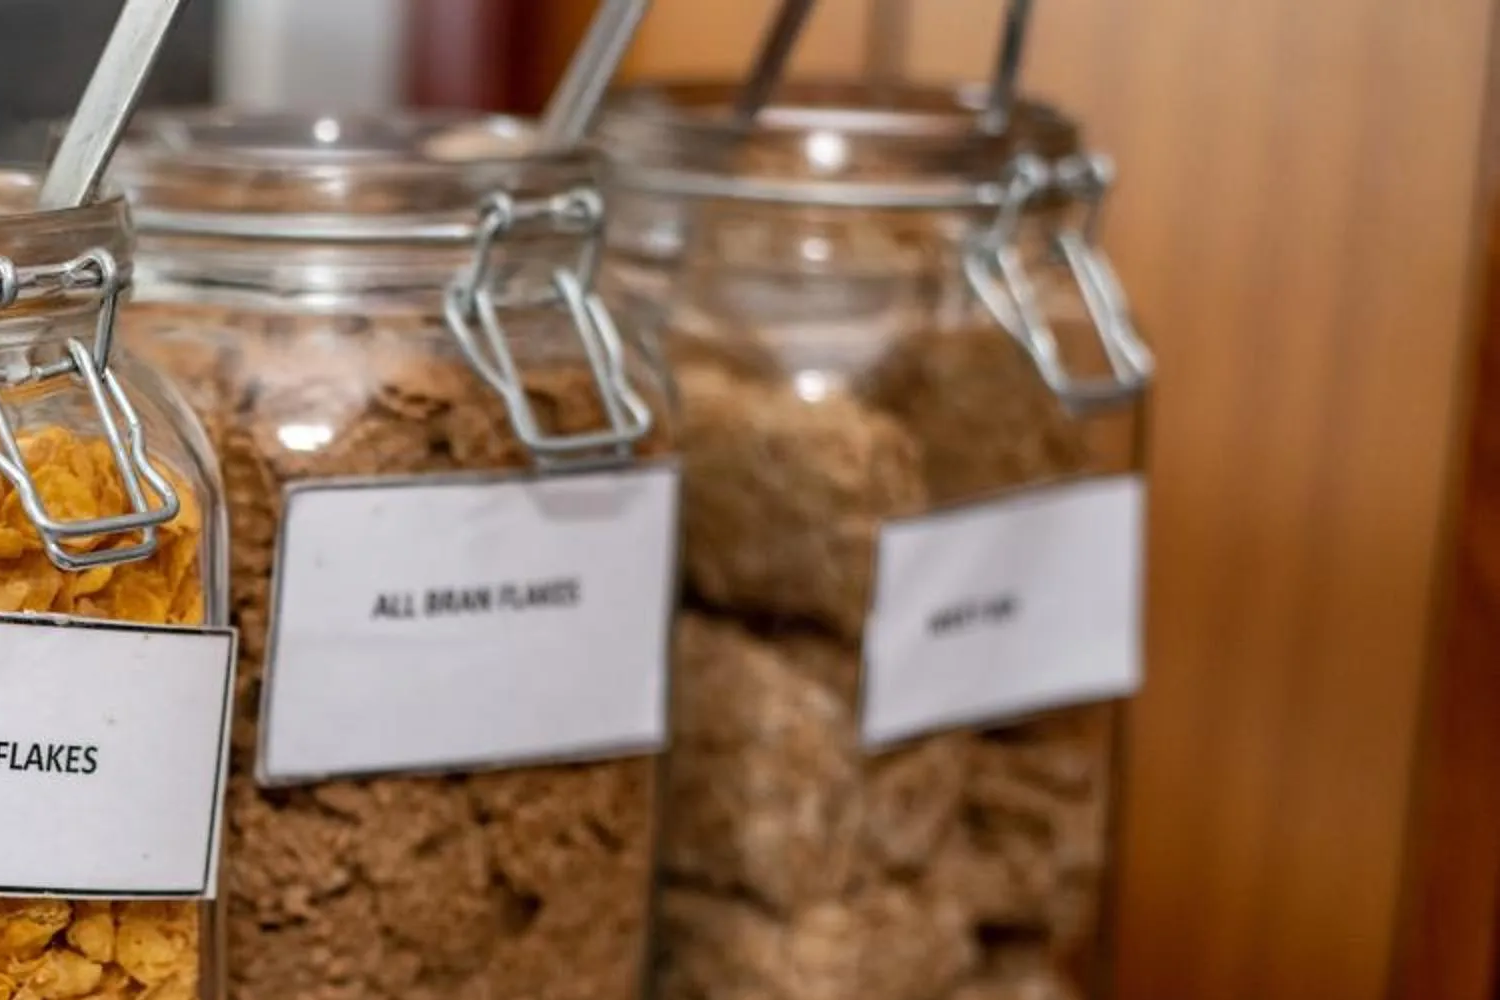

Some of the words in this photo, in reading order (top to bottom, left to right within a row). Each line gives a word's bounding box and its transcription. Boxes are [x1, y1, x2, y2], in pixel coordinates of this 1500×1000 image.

[370, 592, 415, 619] ALL
[423, 587, 492, 617] BRAN
[498, 576, 581, 612] FLAKES
